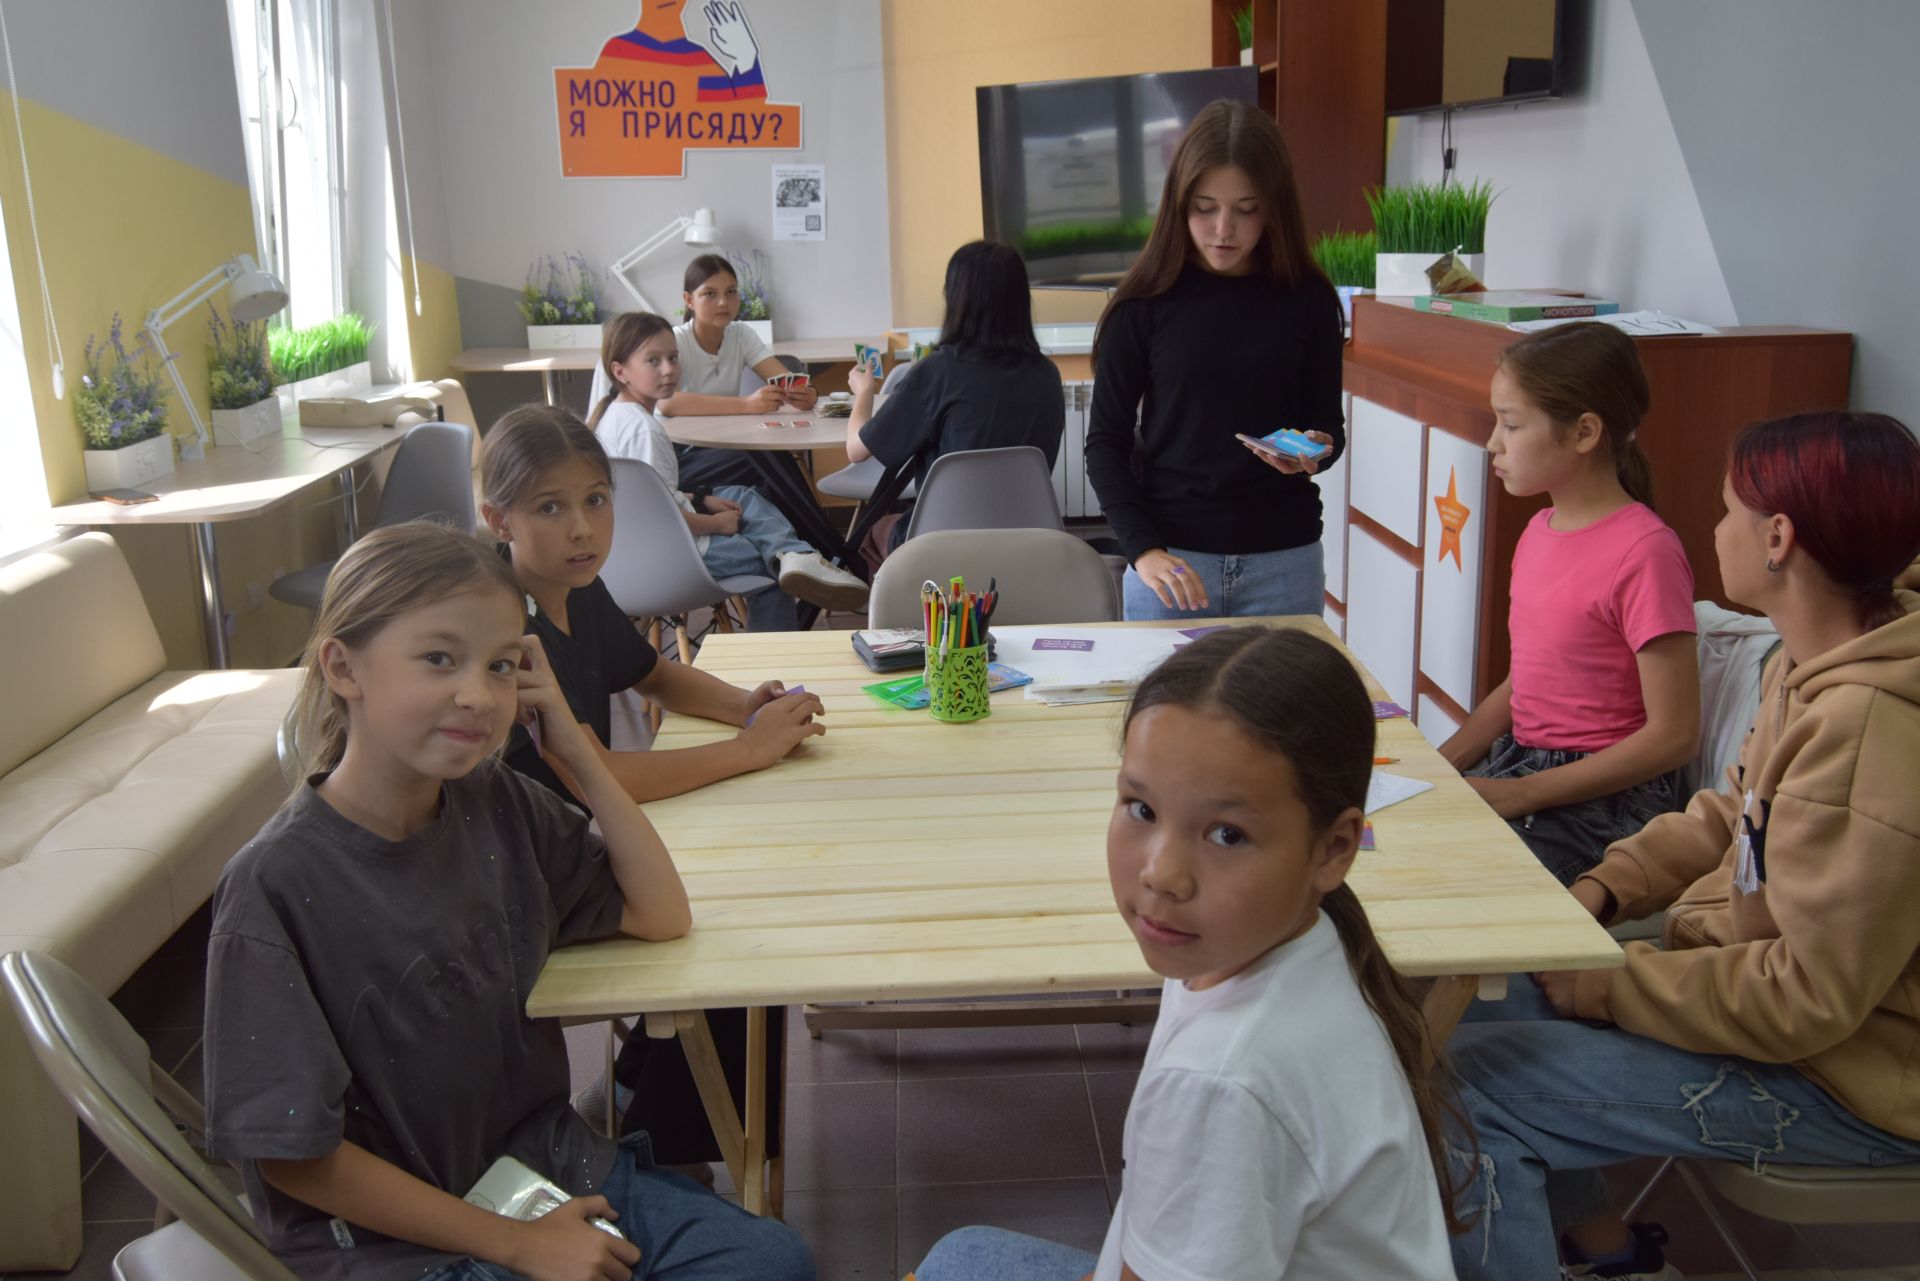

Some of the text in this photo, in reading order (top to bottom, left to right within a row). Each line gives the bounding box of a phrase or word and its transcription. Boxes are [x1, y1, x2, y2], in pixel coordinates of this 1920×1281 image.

[569, 79, 675, 108] МОЖНО
[569, 110, 783, 144] Я ПРИСЯДУ?
